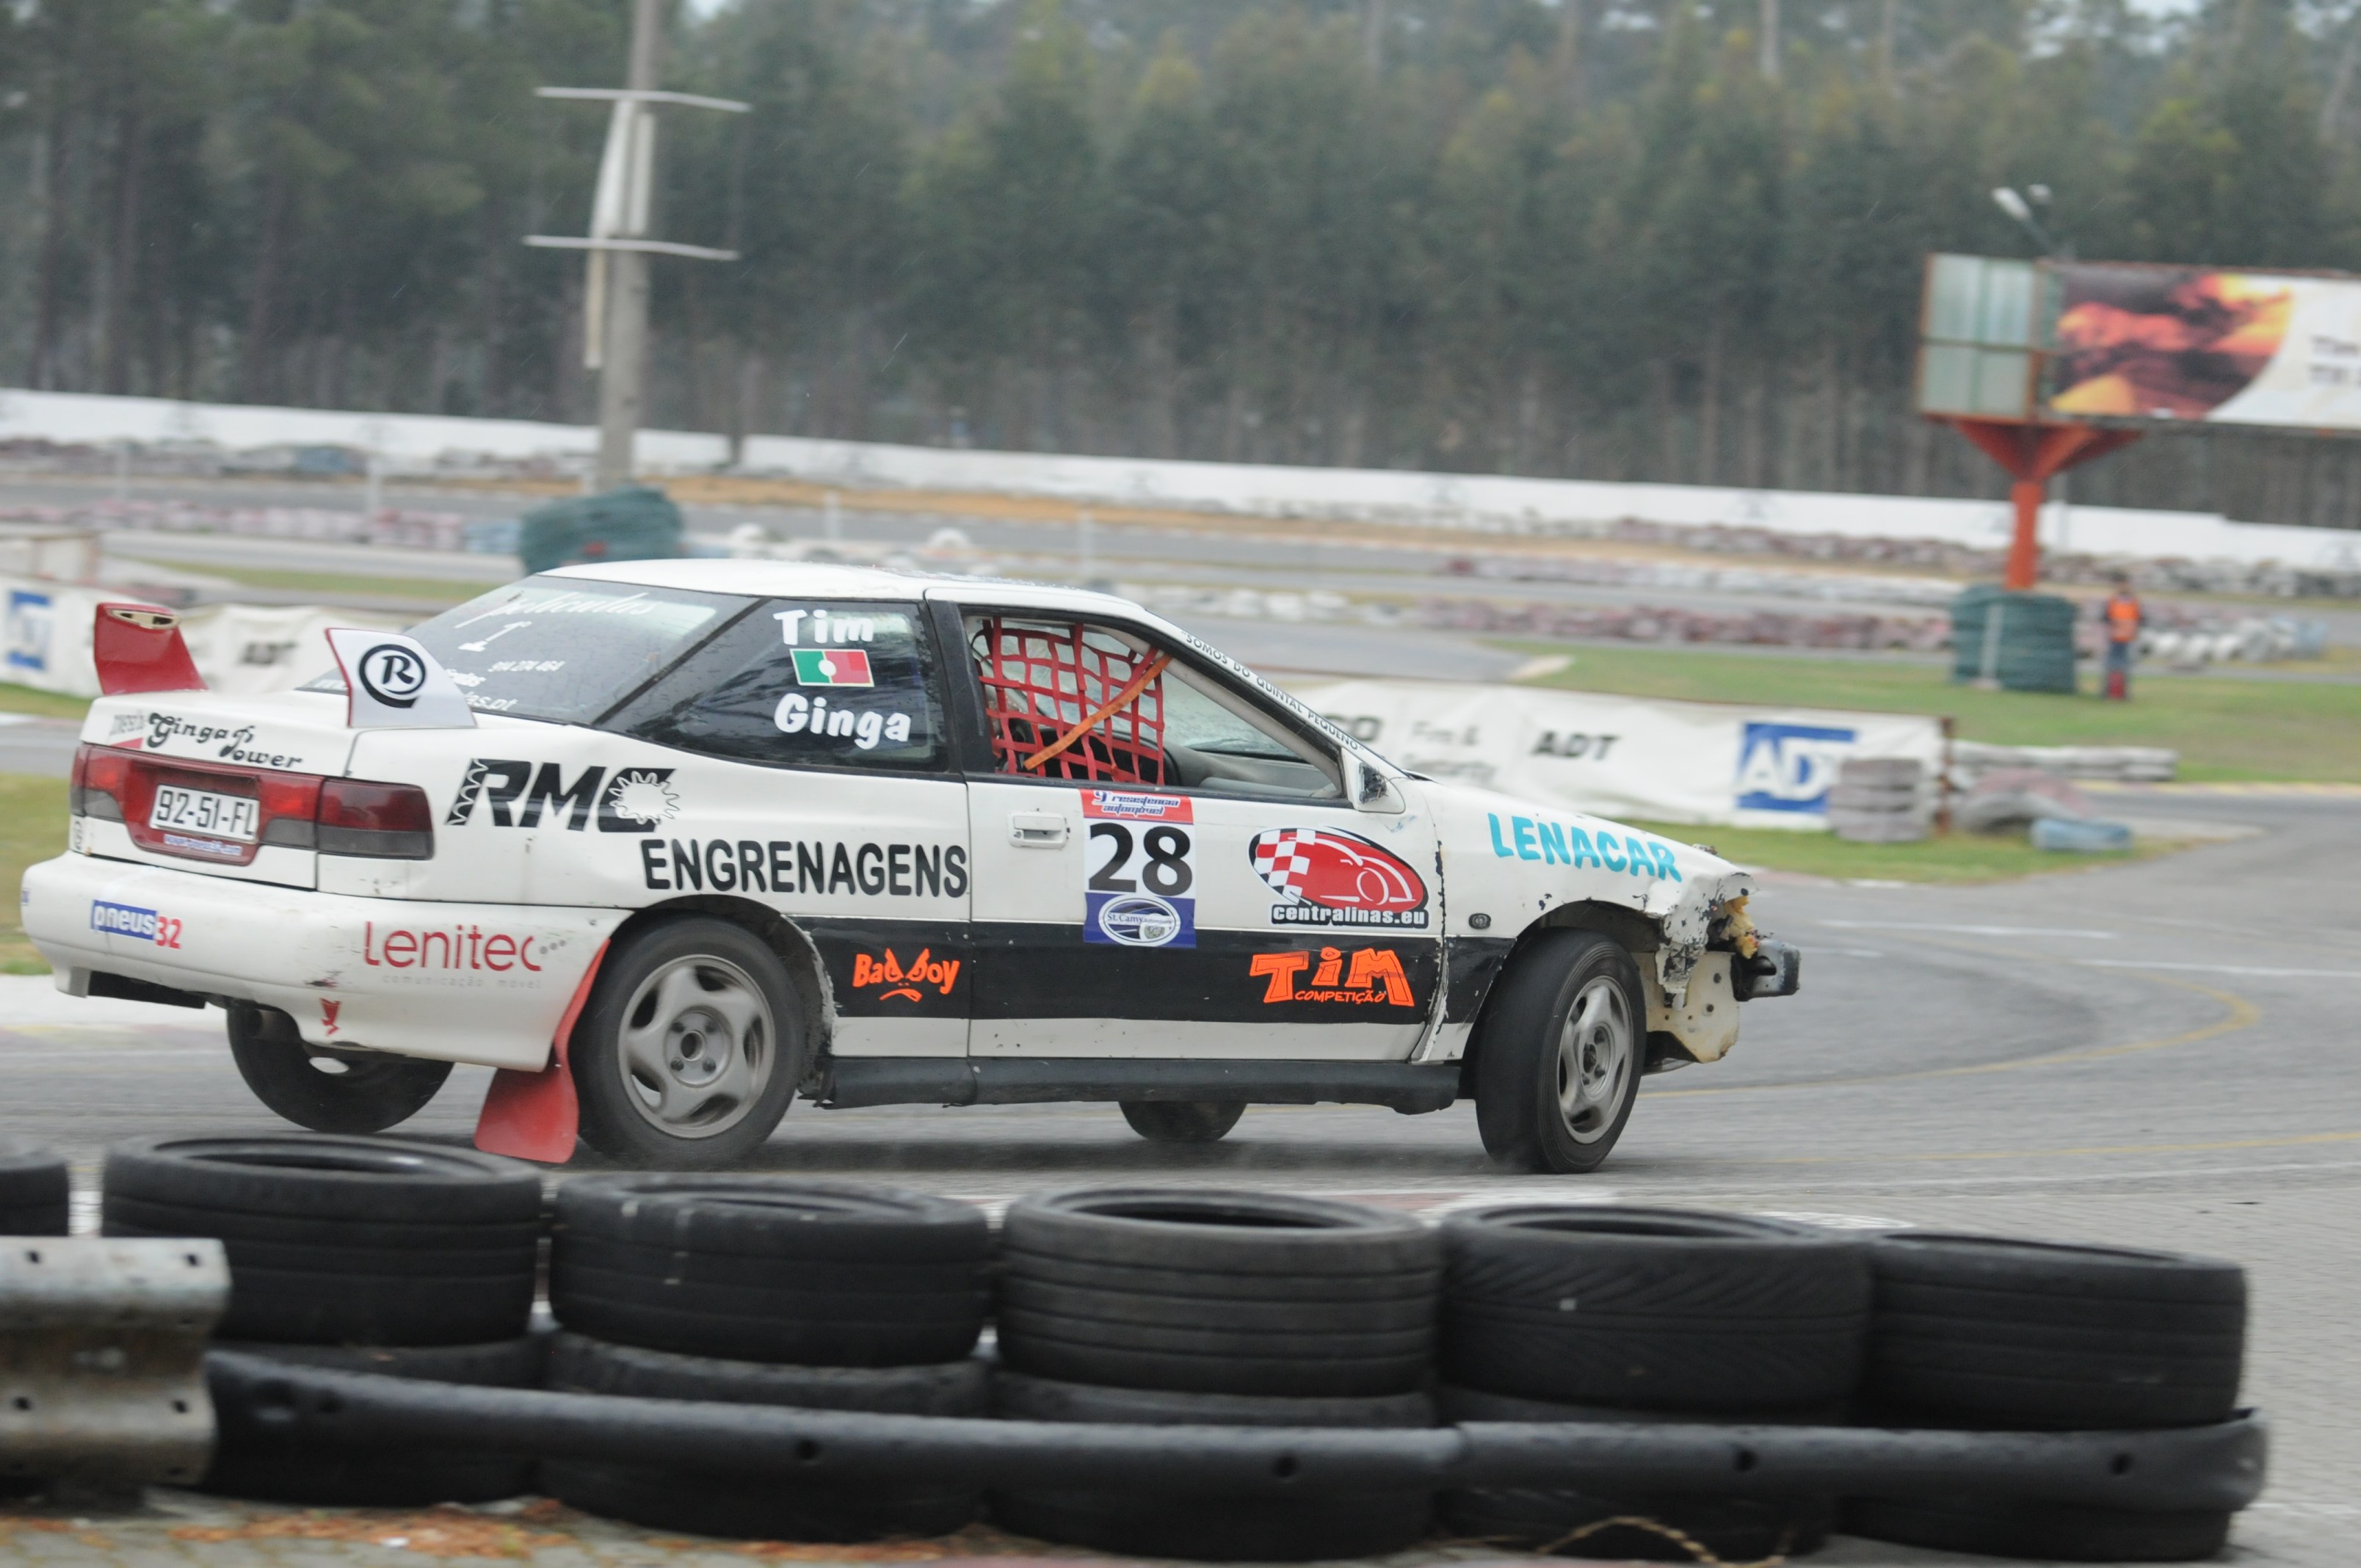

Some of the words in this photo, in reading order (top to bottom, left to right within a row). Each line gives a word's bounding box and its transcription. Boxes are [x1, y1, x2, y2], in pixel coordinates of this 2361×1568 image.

[772, 609, 874, 645] Tim
[1233, 662, 1251, 678] DO
[1256, 678, 1302, 713] QUINTAL
[147, 713, 229, 748] Ginga
[774, 692, 911, 749] Ginga
[220, 725, 302, 768] Power
[1530, 730, 1621, 761] ADT
[156, 790, 254, 835] 92-51-FL
[641, 839, 968, 898] ENGRENAGENS
[1089, 822, 1193, 896] 28
[1487, 813, 1683, 883] LENACAR
[1272, 906, 1426, 925] centralinas.eu
[1294, 990, 1387, 1004] COMPETIÇÃO
